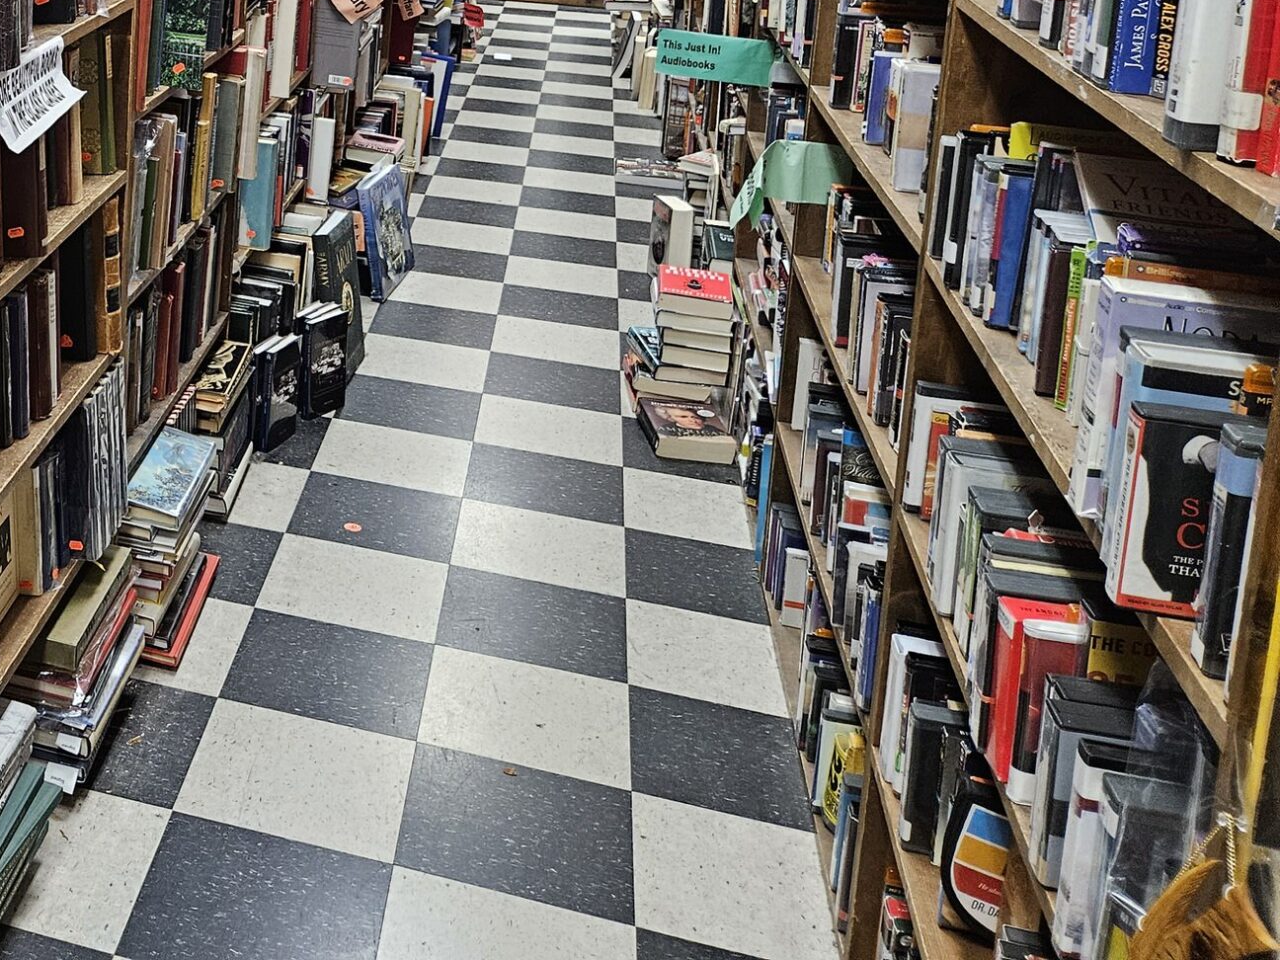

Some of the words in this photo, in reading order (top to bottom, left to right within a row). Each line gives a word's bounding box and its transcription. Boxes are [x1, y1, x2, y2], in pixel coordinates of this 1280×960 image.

[1161, 1, 1177, 30] ALEX
[663, 39, 682, 51] This
[684, 41, 707, 53] Just
[709, 44, 721, 56] In!
[1124, 18, 1146, 70] JAMES
[1156, 31, 1173, 73] CROSS
[660, 57, 716, 71] Audiobooks
[1173, 555, 1195, 565] THE
